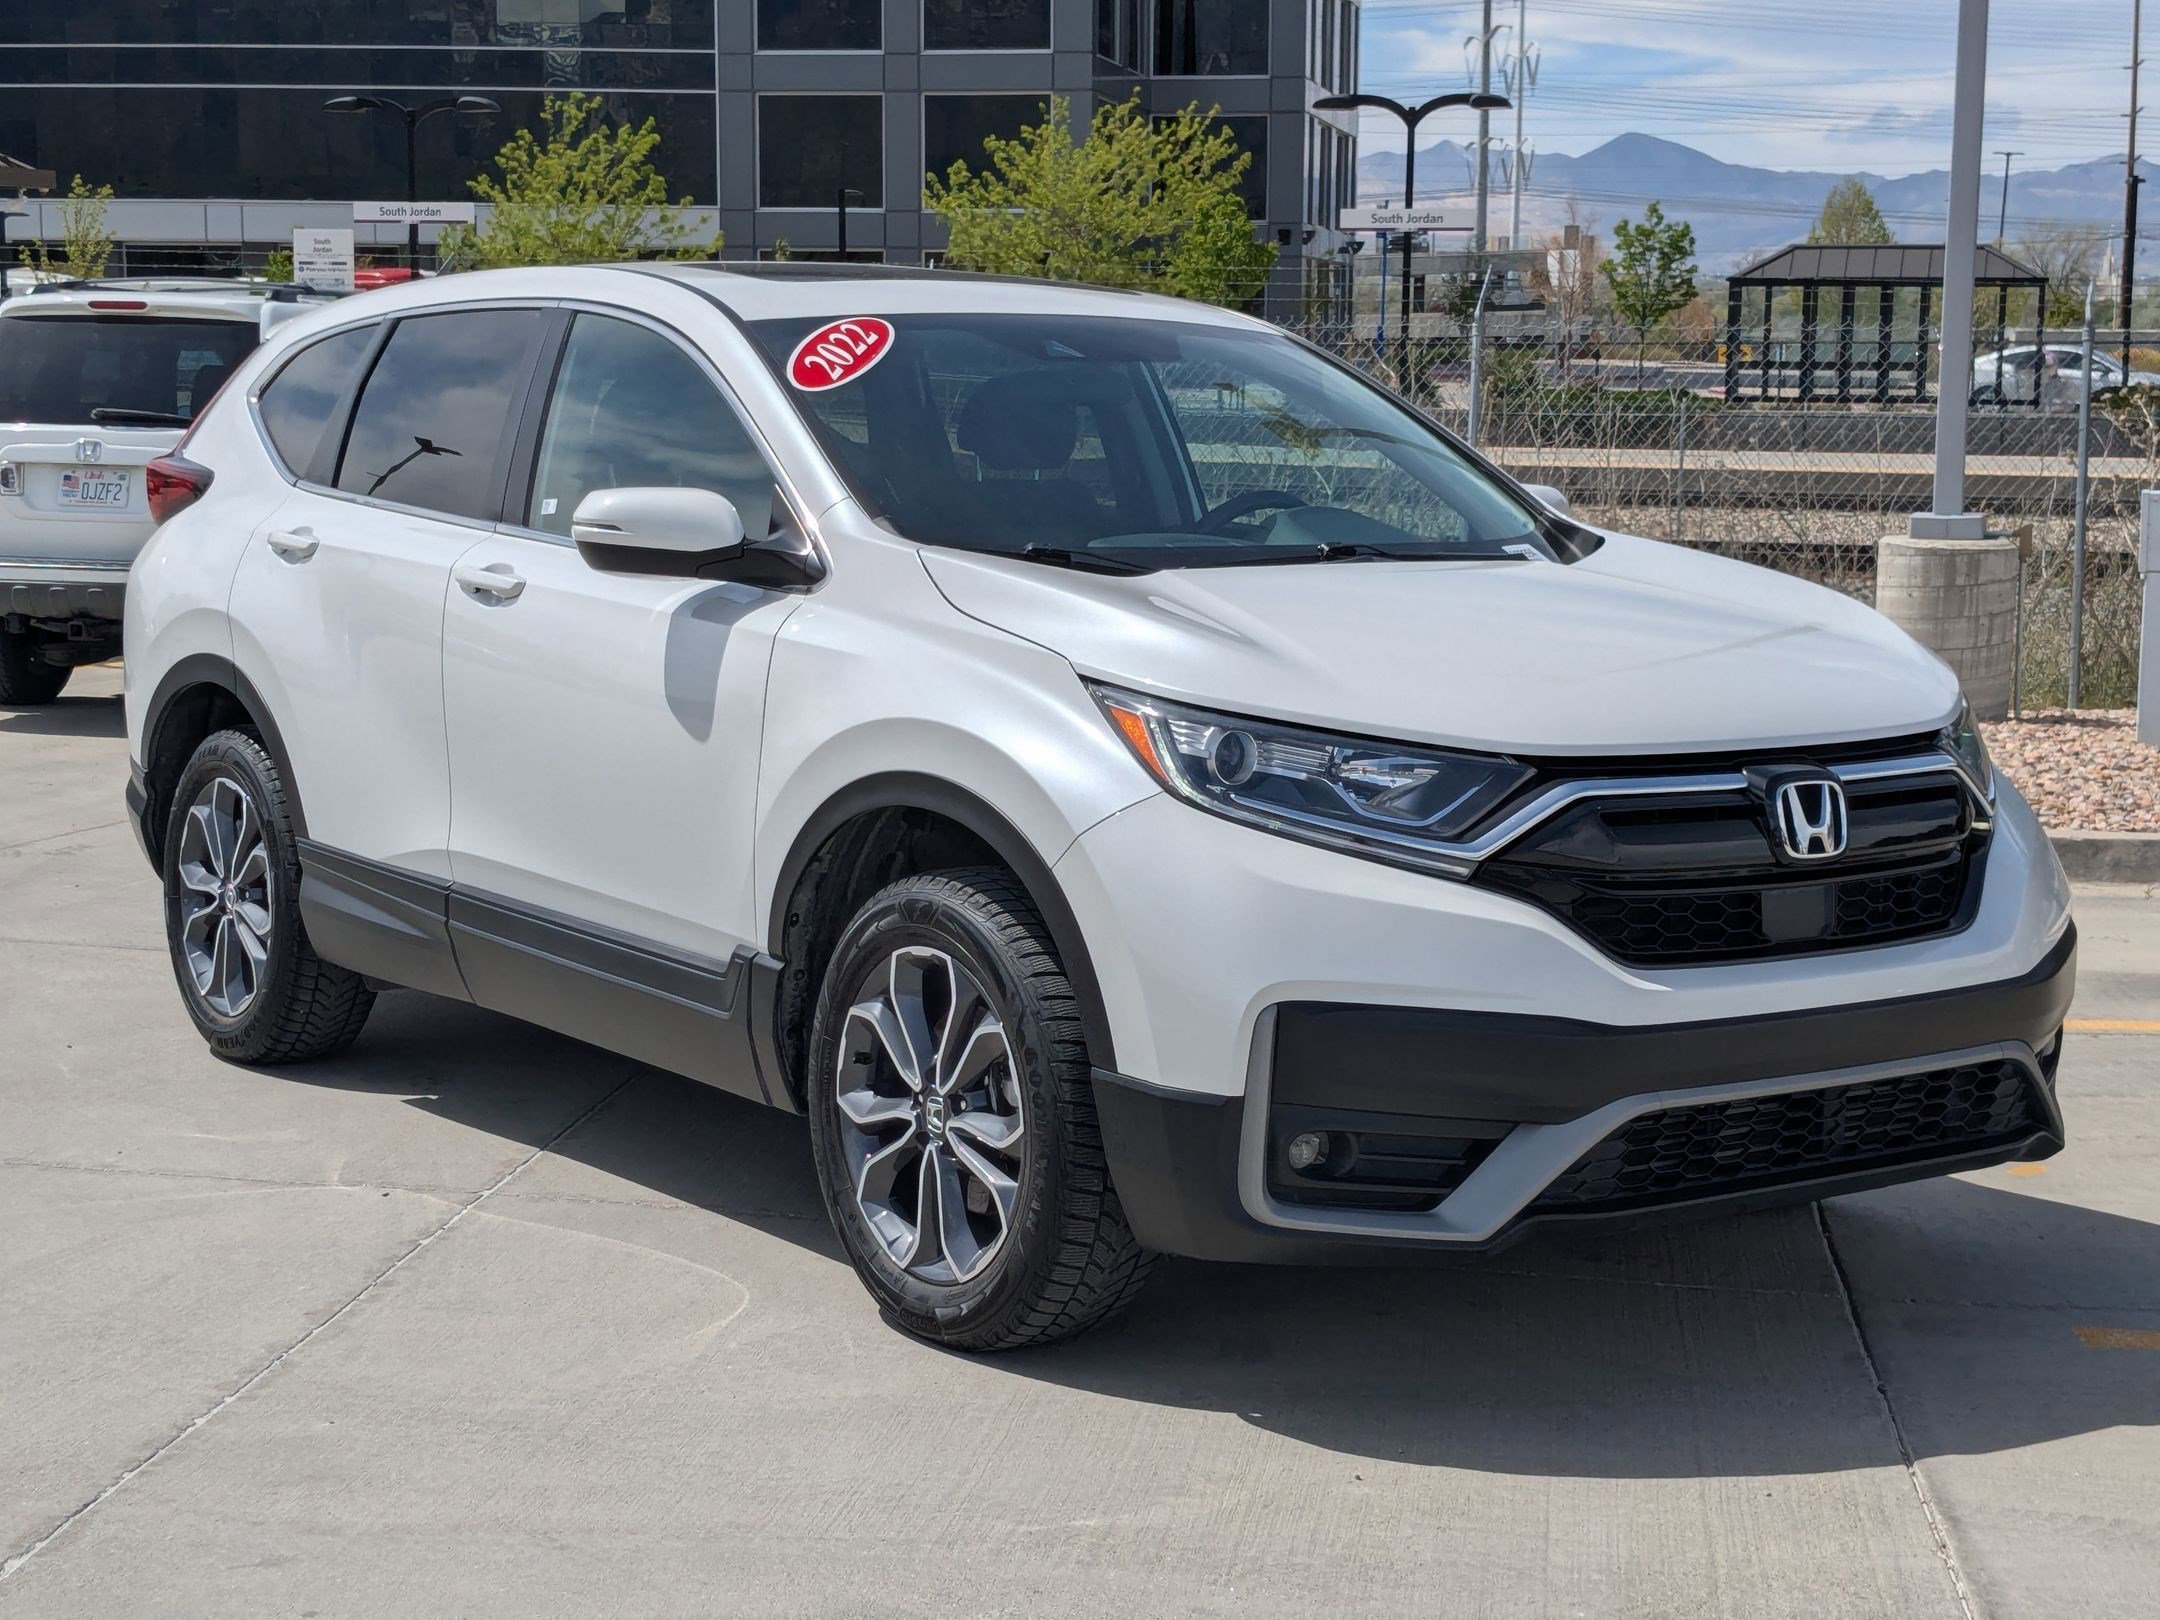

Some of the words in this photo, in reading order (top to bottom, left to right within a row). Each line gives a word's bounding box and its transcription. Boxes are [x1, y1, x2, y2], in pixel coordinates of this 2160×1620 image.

[379, 206, 407, 217] South
[409, 206, 441, 217] Jordan
[1371, 213, 1403, 224] South
[1406, 213, 1443, 224] Jordan
[804, 323, 879, 381] 2022
